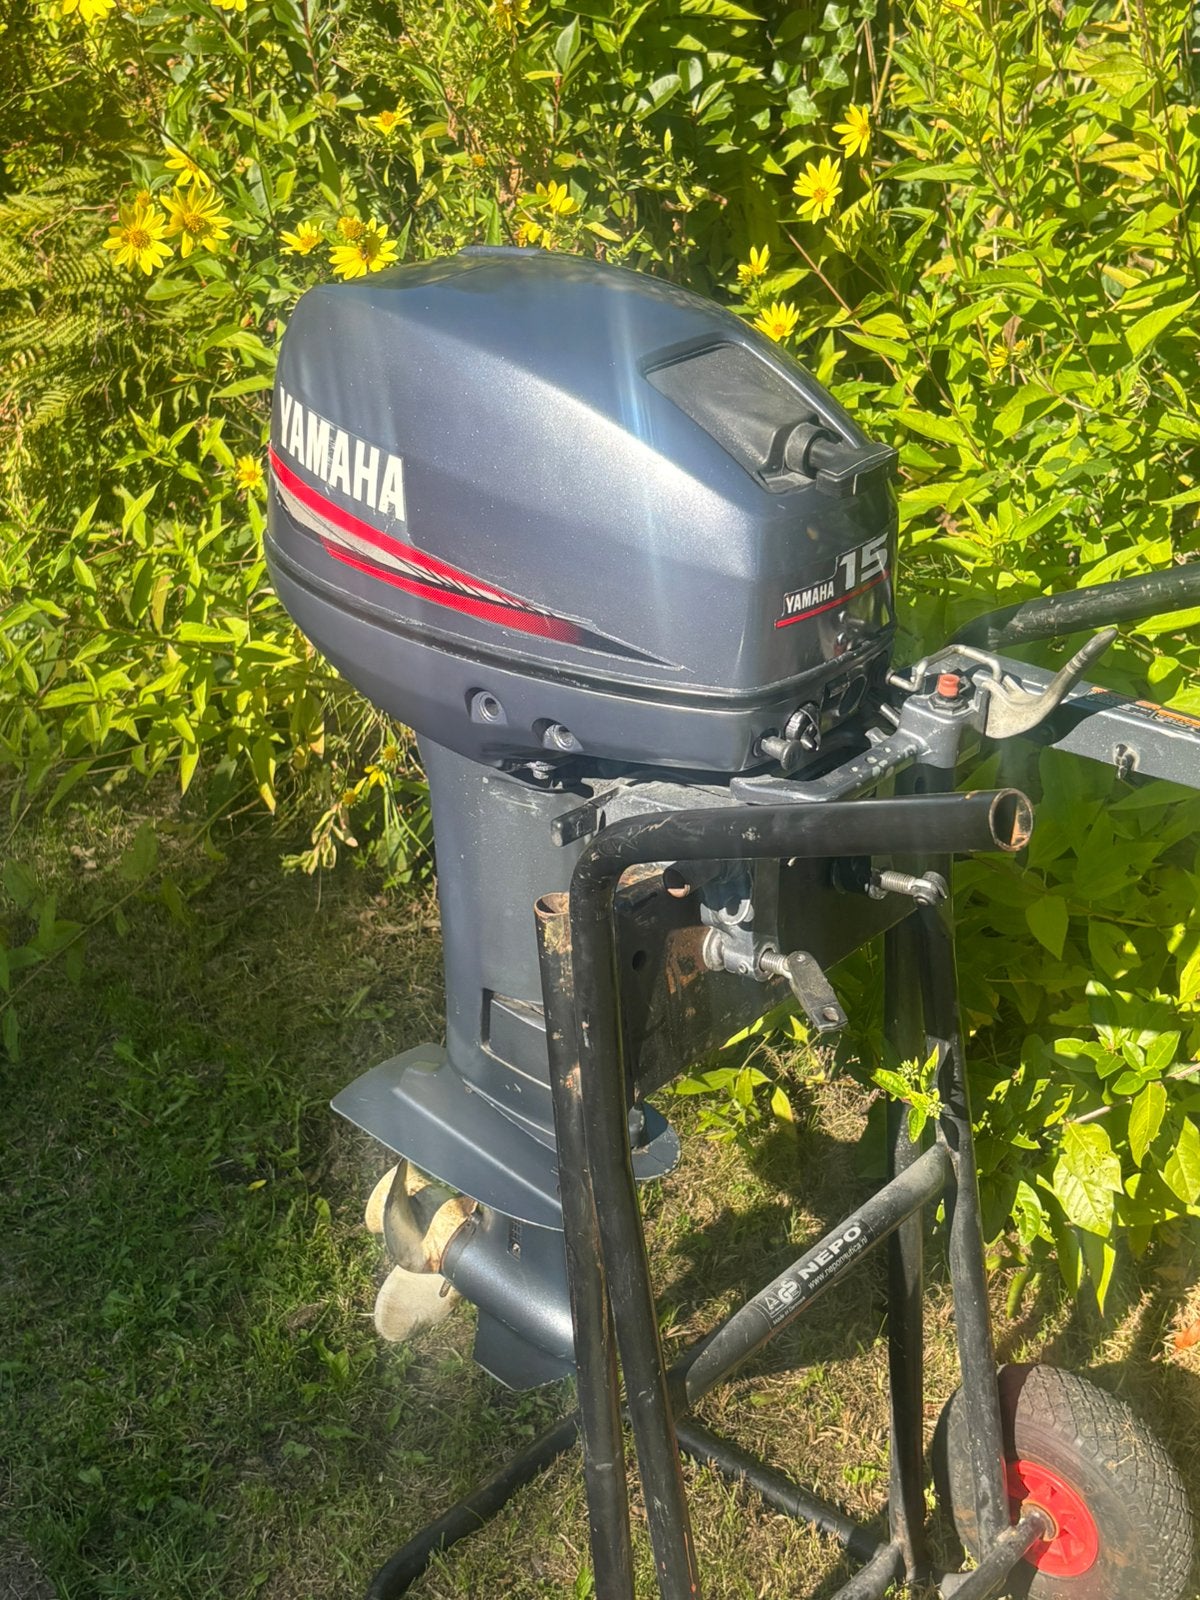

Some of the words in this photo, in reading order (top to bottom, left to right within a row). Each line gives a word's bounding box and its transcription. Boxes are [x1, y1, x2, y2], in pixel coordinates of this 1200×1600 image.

[279, 385, 406, 522] YAMAHA
[785, 580, 835, 614] YAMAHA
[839, 532, 888, 591] 15
[798, 1226, 862, 1280] NEPO
